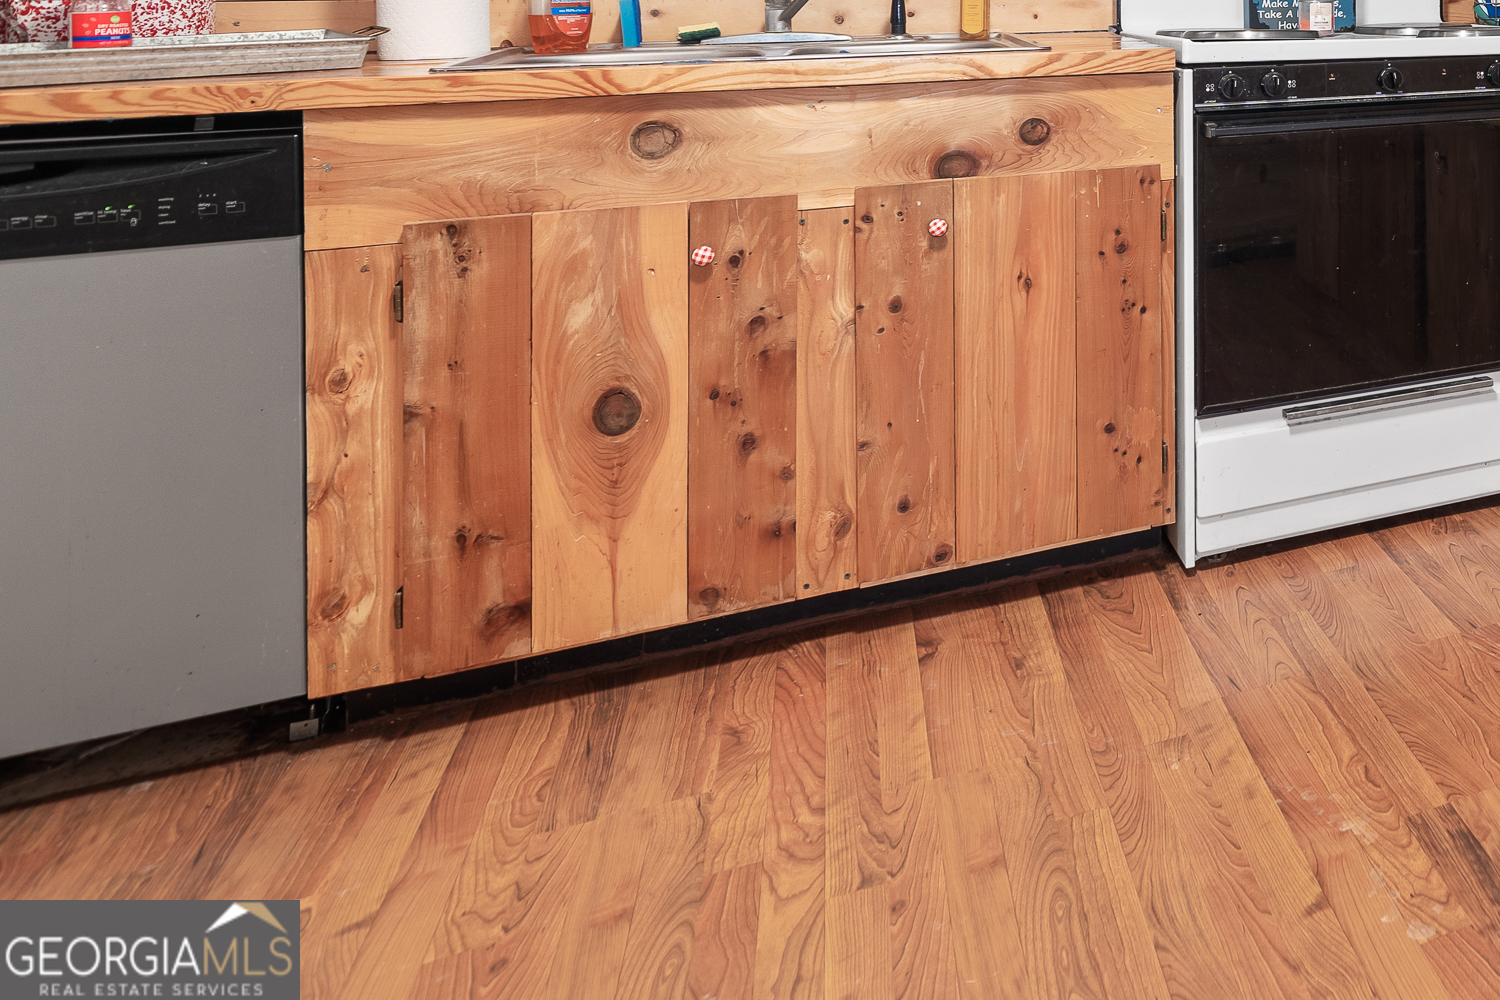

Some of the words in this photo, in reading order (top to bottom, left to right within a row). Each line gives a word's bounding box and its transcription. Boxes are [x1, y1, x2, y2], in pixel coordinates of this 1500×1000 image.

[1262, 0, 1288, 8] Make
[1257, 10, 1283, 19] Take
[1285, 10, 1293, 18] A
[1279, 21, 1300, 30] Hav
[94, 27, 131, 36] PEANUTS
